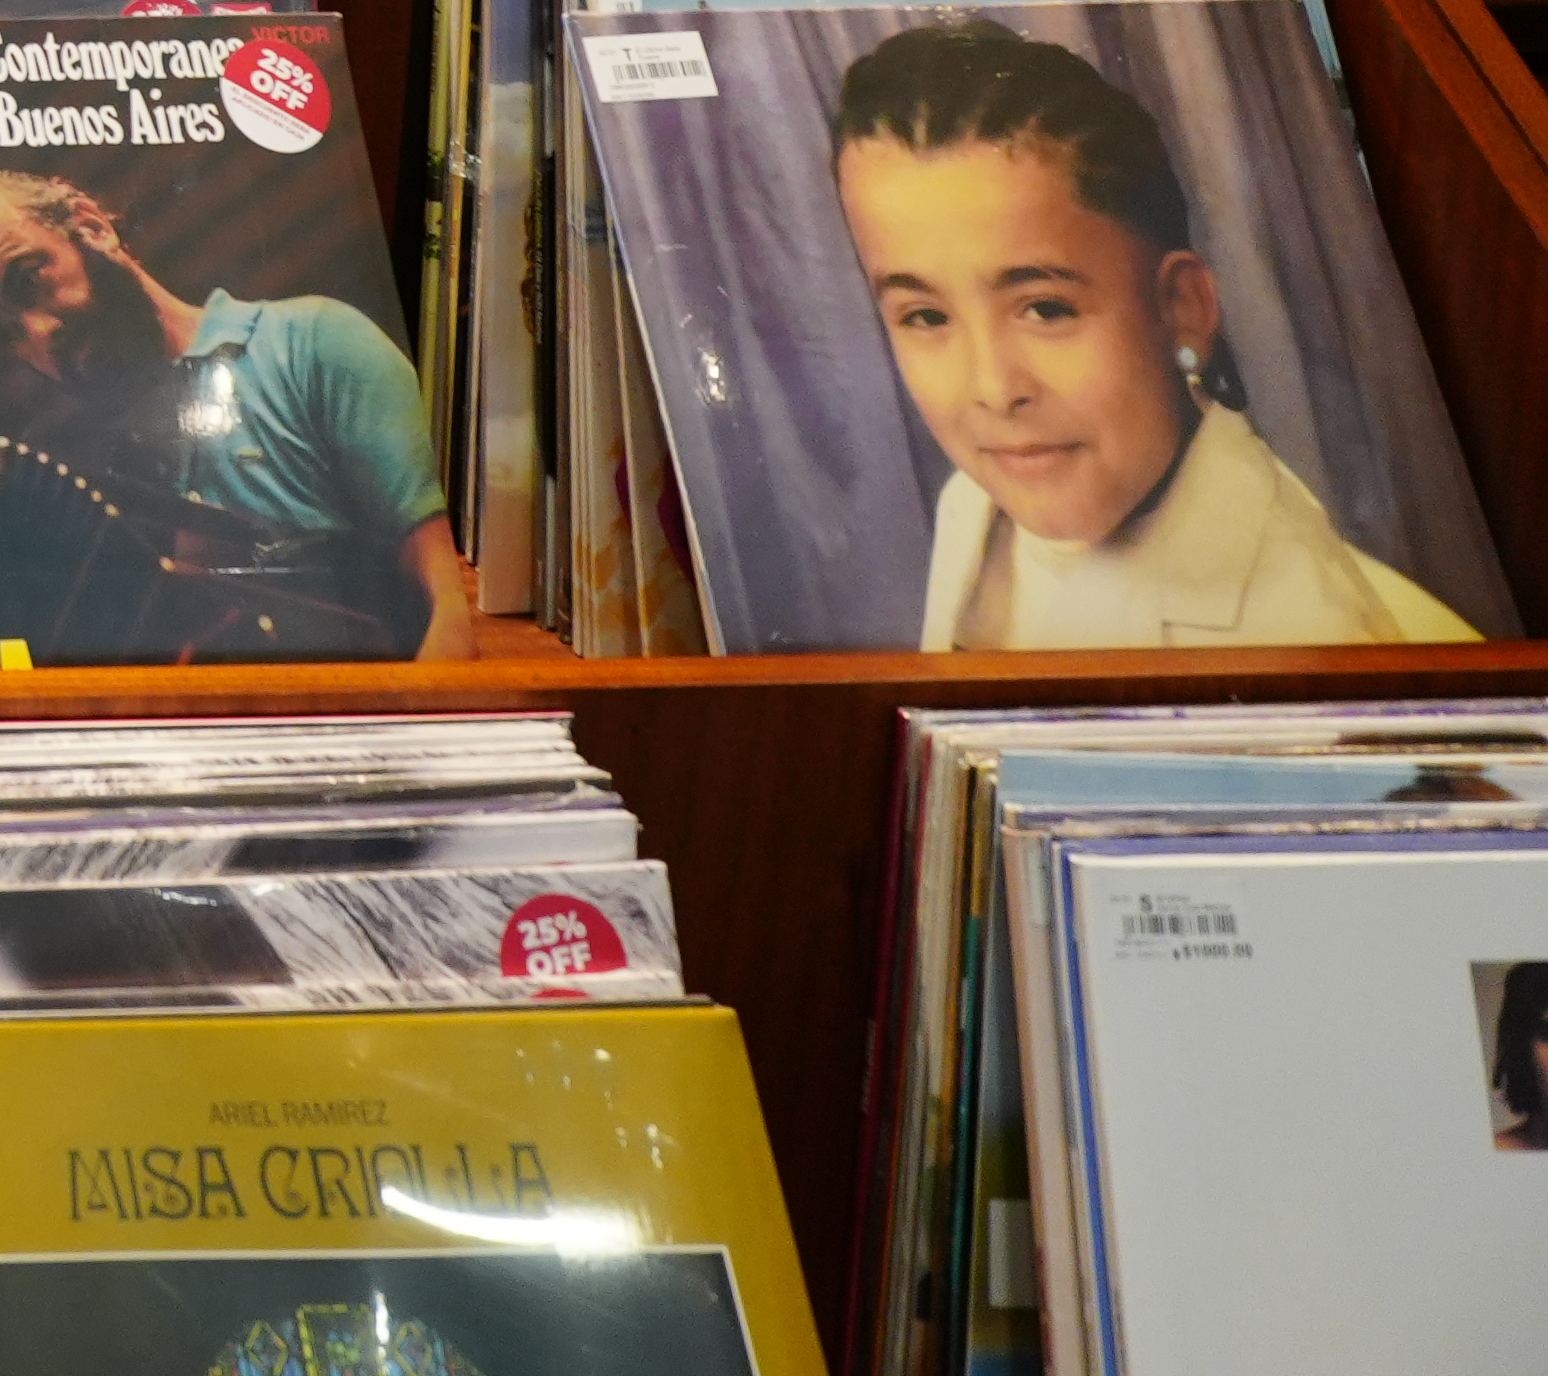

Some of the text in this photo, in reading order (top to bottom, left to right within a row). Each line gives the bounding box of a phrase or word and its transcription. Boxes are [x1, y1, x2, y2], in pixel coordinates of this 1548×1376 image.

[250, 25, 332, 45] VICTOR
[129, 86, 226, 145] Aires
[517, 912, 587, 949] 25%
[209, 1101, 277, 1127] ARIEL
[70, 1147, 247, 1221] MISA
